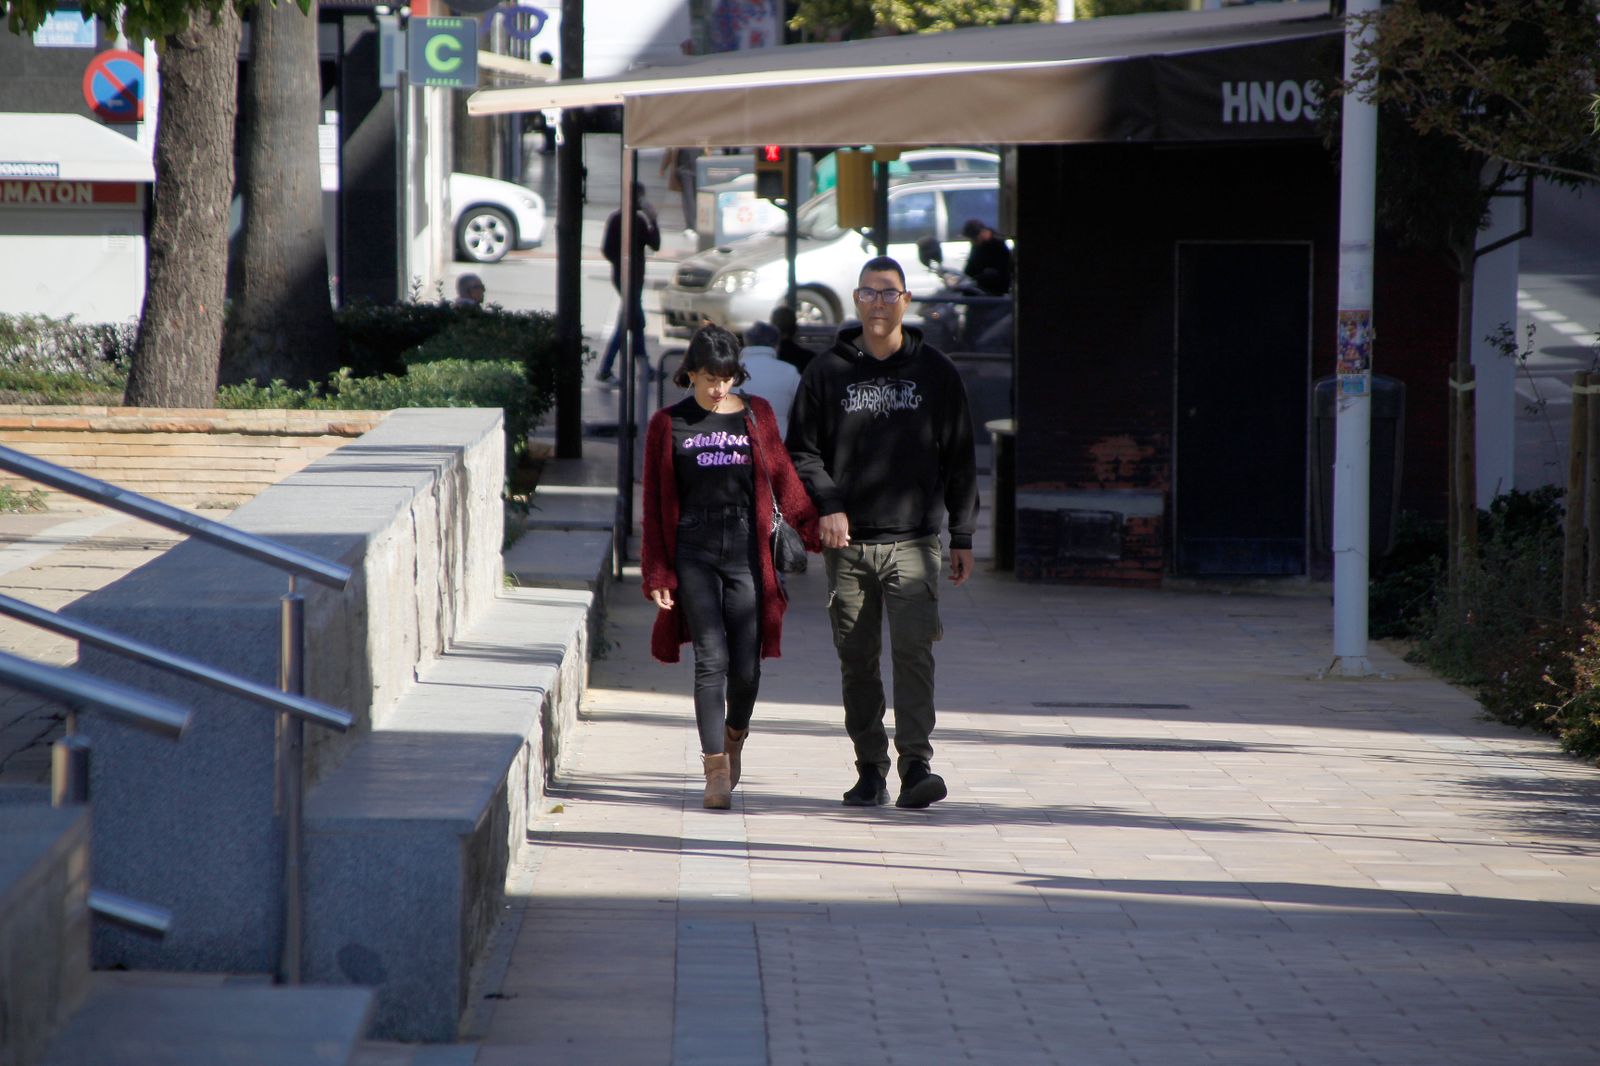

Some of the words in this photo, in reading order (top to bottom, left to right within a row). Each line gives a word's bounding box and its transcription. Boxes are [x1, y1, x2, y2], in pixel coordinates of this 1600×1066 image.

[424, 33, 463, 73] C
[1222, 79, 1323, 122] HNOS
[0, 182, 94, 203] MATON
